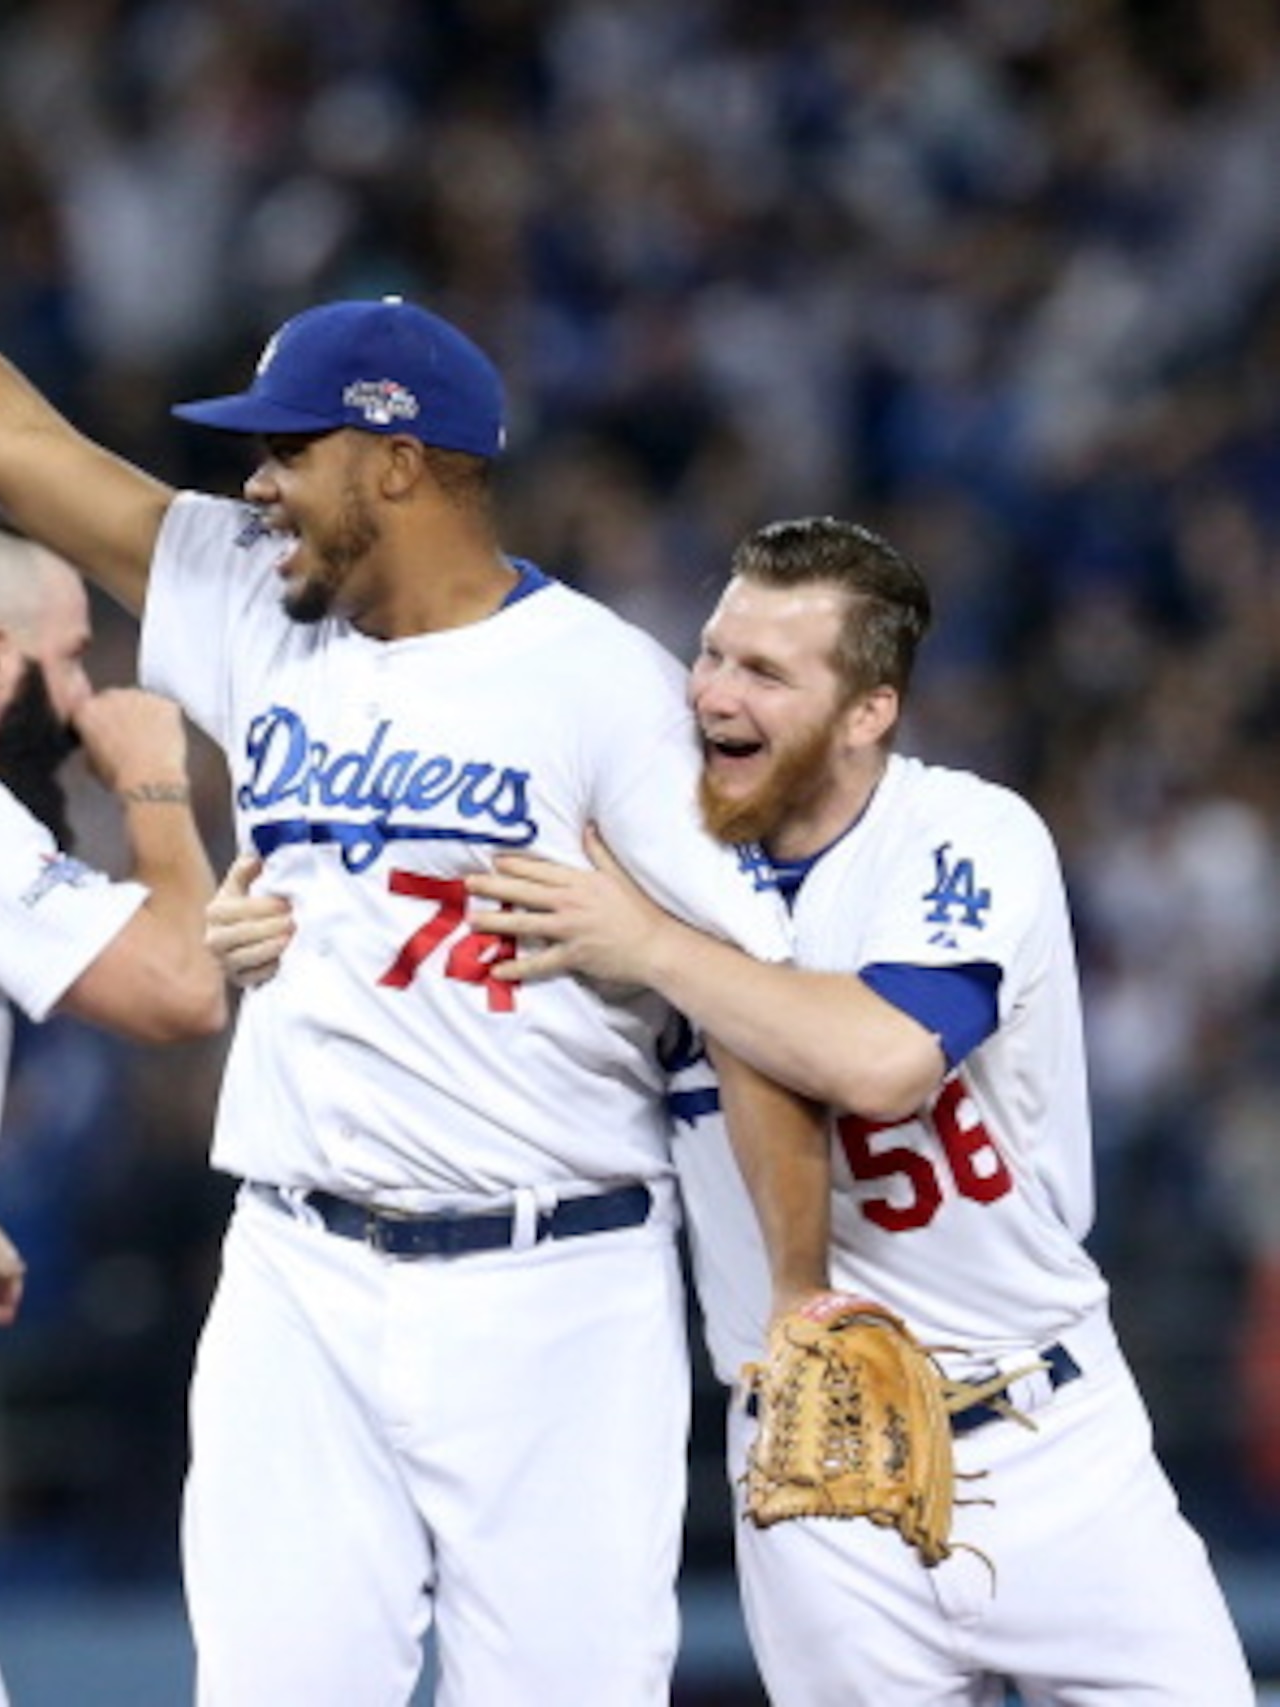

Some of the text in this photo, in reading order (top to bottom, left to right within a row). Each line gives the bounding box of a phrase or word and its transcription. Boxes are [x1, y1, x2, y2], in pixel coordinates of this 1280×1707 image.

[237, 705, 539, 876] Dodgers
[376, 868, 523, 1013] 74
[922, 840, 991, 931] LA
[836, 1078, 1014, 1233] 56
